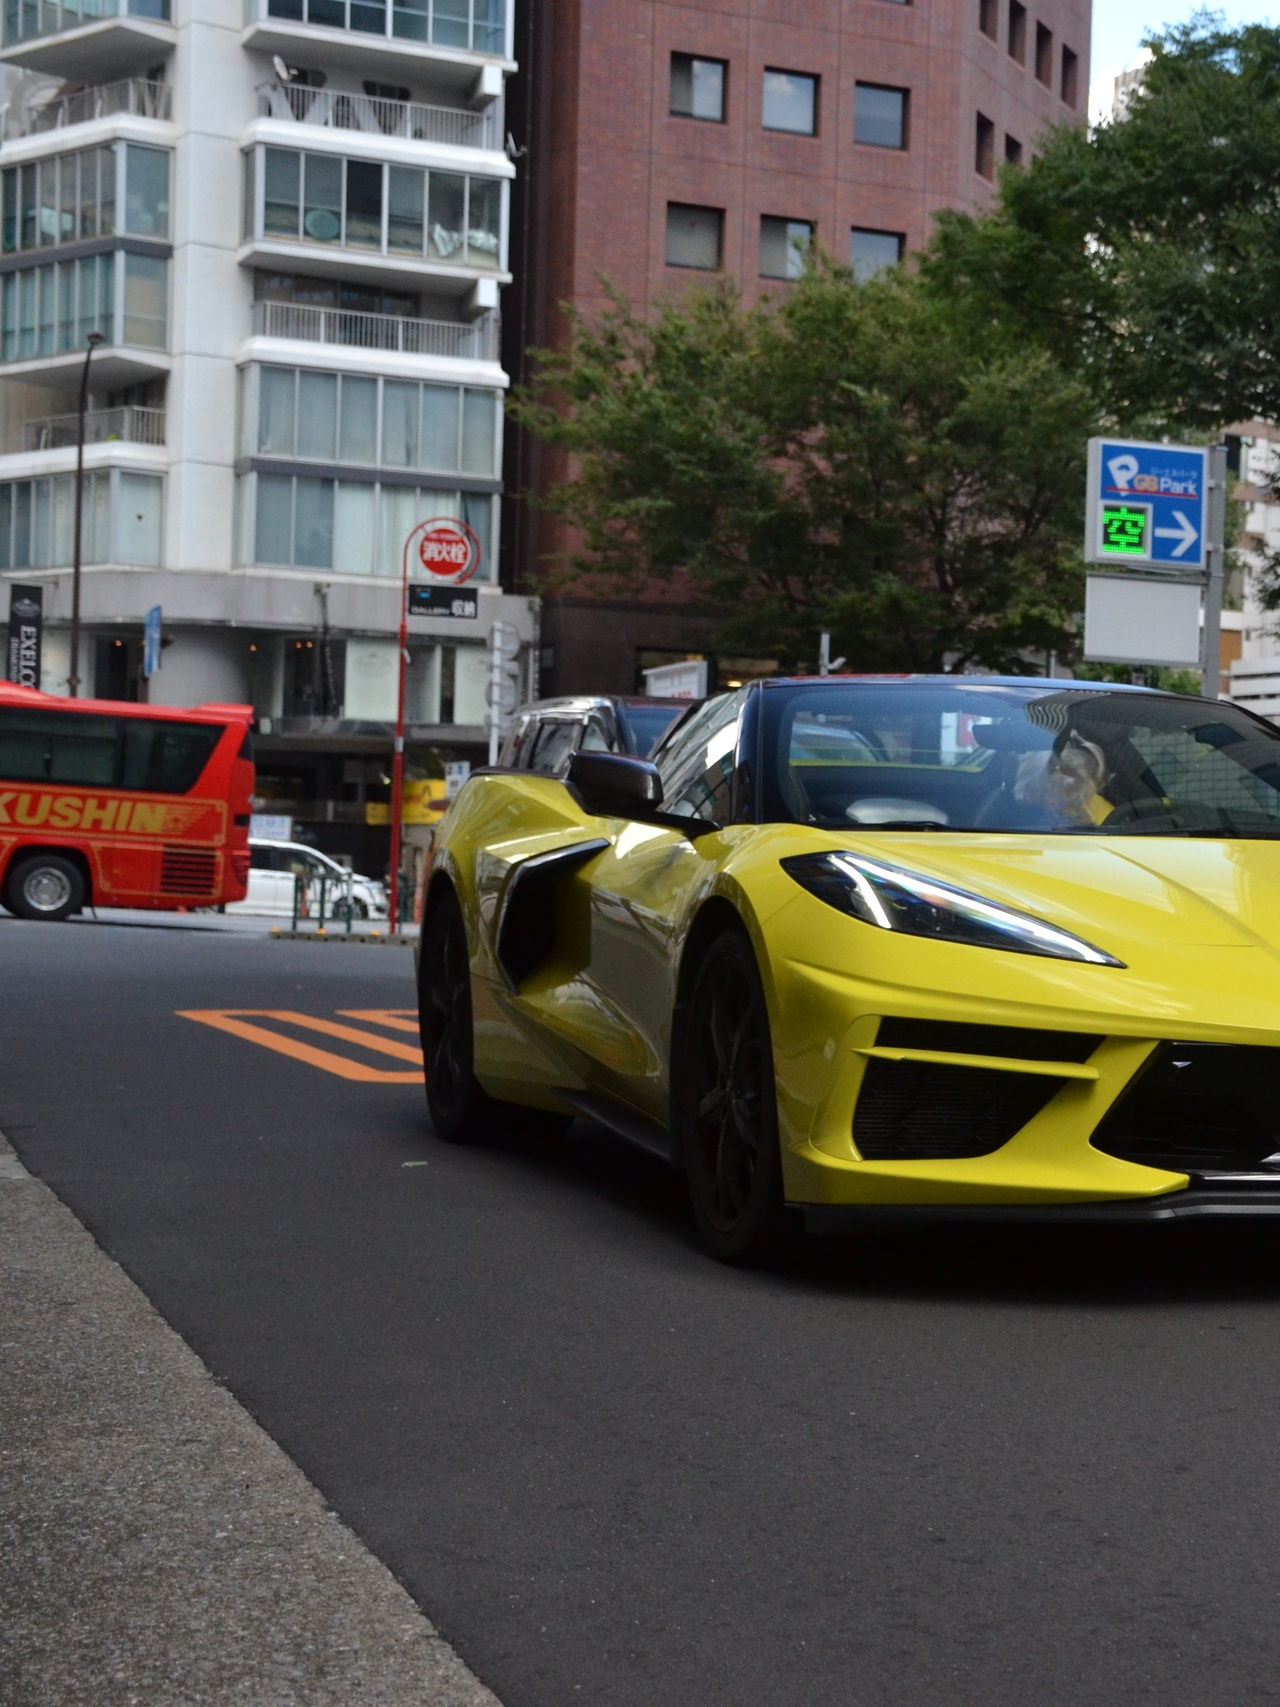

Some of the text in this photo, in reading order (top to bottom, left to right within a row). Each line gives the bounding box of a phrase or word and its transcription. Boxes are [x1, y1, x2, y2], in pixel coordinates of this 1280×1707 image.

[1133, 474, 1197, 495] GS Park
[1101, 506, 1145, 555] 空
[423, 540, 467, 563] 消火栓
